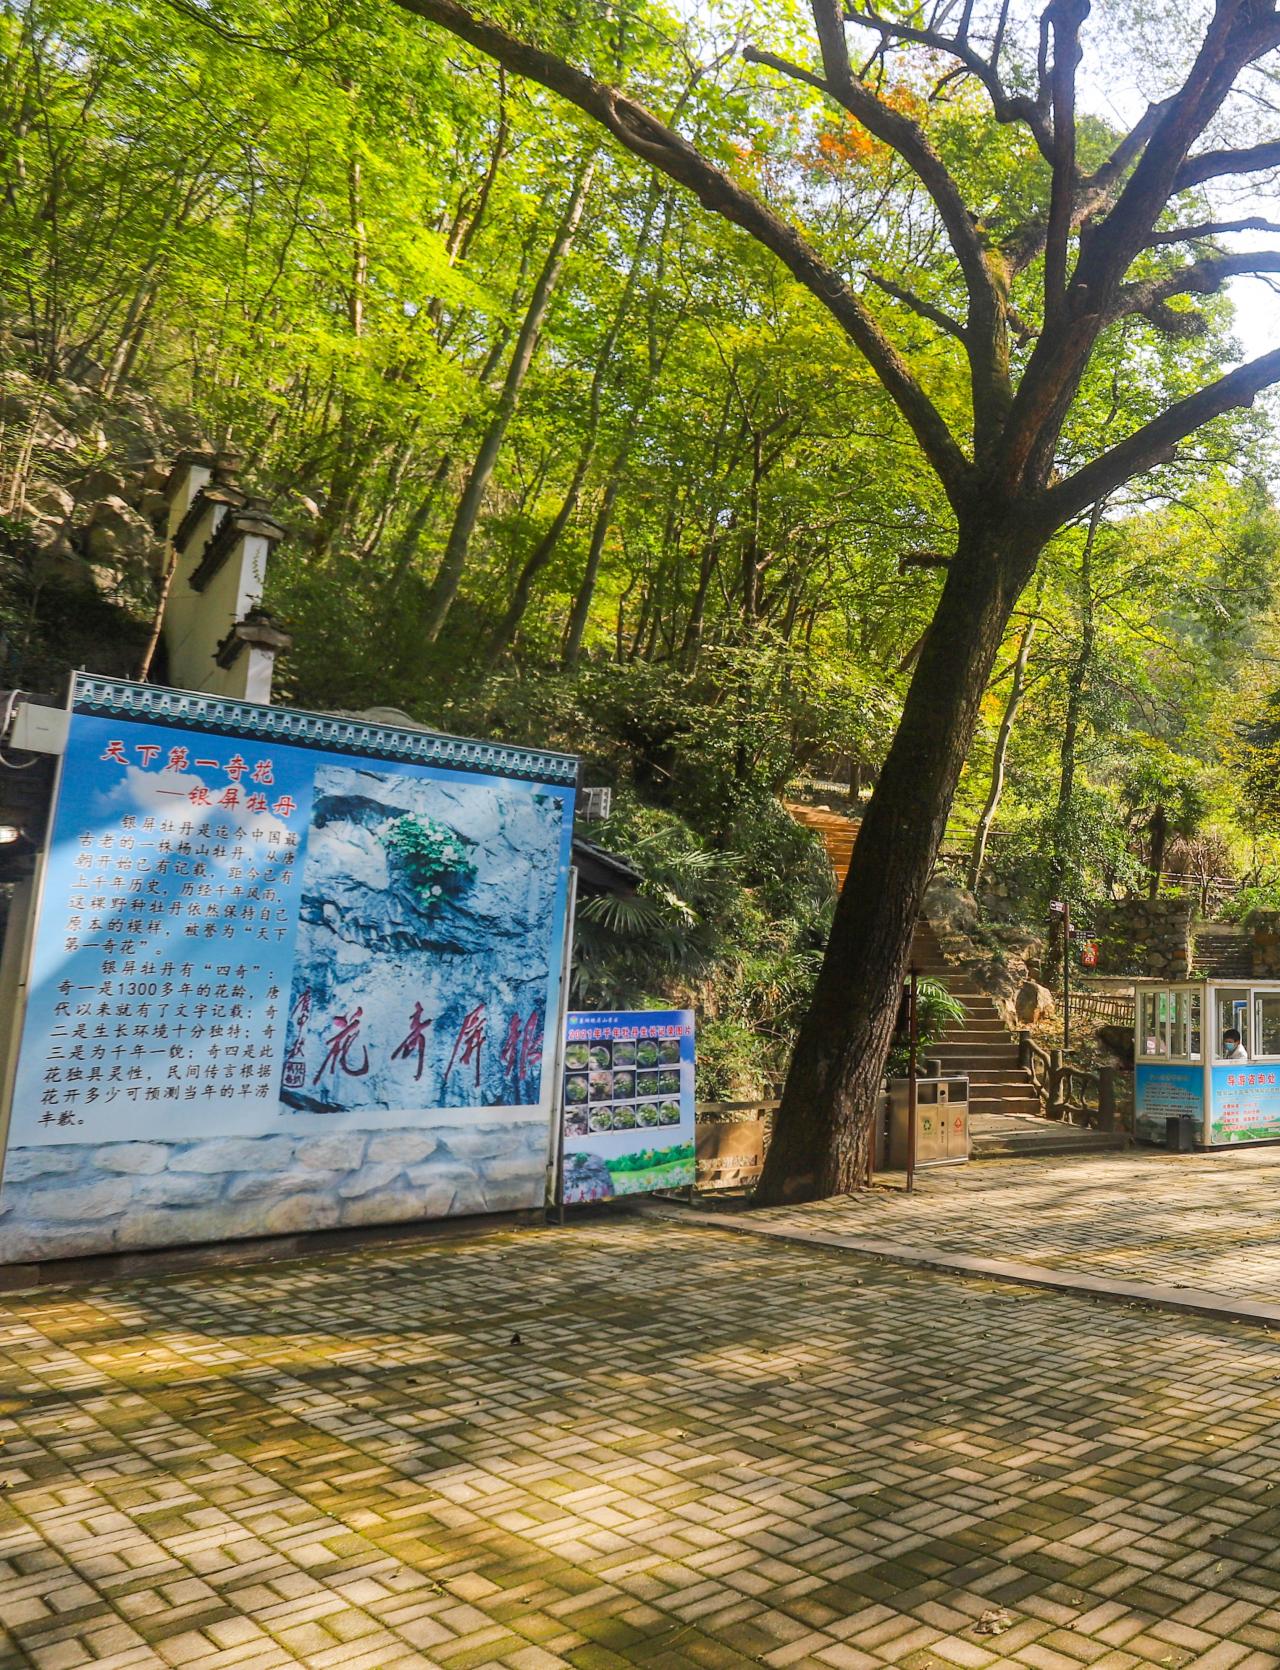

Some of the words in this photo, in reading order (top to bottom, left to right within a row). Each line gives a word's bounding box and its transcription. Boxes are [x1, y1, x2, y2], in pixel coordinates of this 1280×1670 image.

[100, 740, 275, 785] 天下第一奇花
[121, 815, 298, 847] 银屏牡丹是迄今中国最
[40, 1084, 270, 1105] 花开多少可预测当年的旱涝
